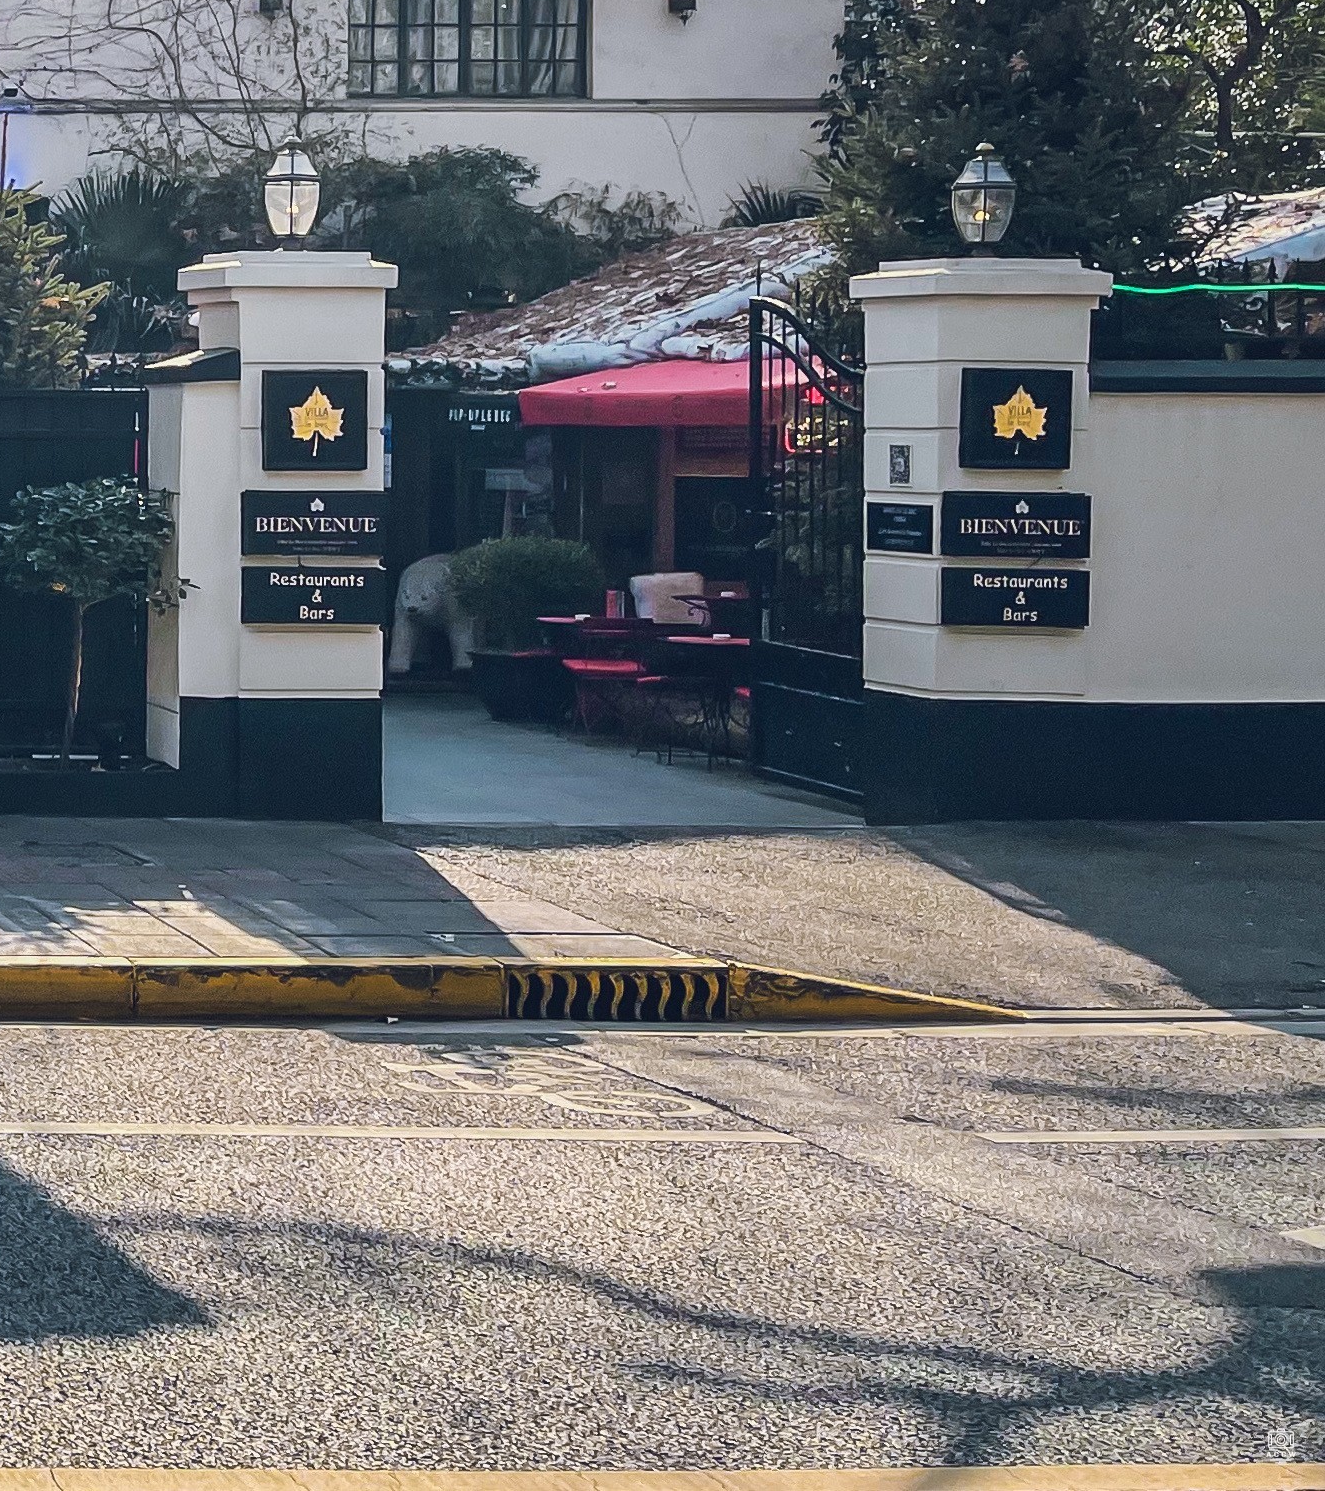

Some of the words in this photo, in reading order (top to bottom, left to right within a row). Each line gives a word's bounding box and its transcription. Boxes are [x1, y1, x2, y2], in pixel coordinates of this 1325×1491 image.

[255, 516, 378, 533] BIENVENUE
[959, 518, 1081, 536] BIENVENUE
[269, 572, 365, 588] Restaurants
[973, 573, 1069, 589] Restaurants
[311, 590, 323, 603] &
[1015, 592, 1026, 605] &
[299, 605, 335, 621] Bars
[1003, 607, 1038, 623] Bars
